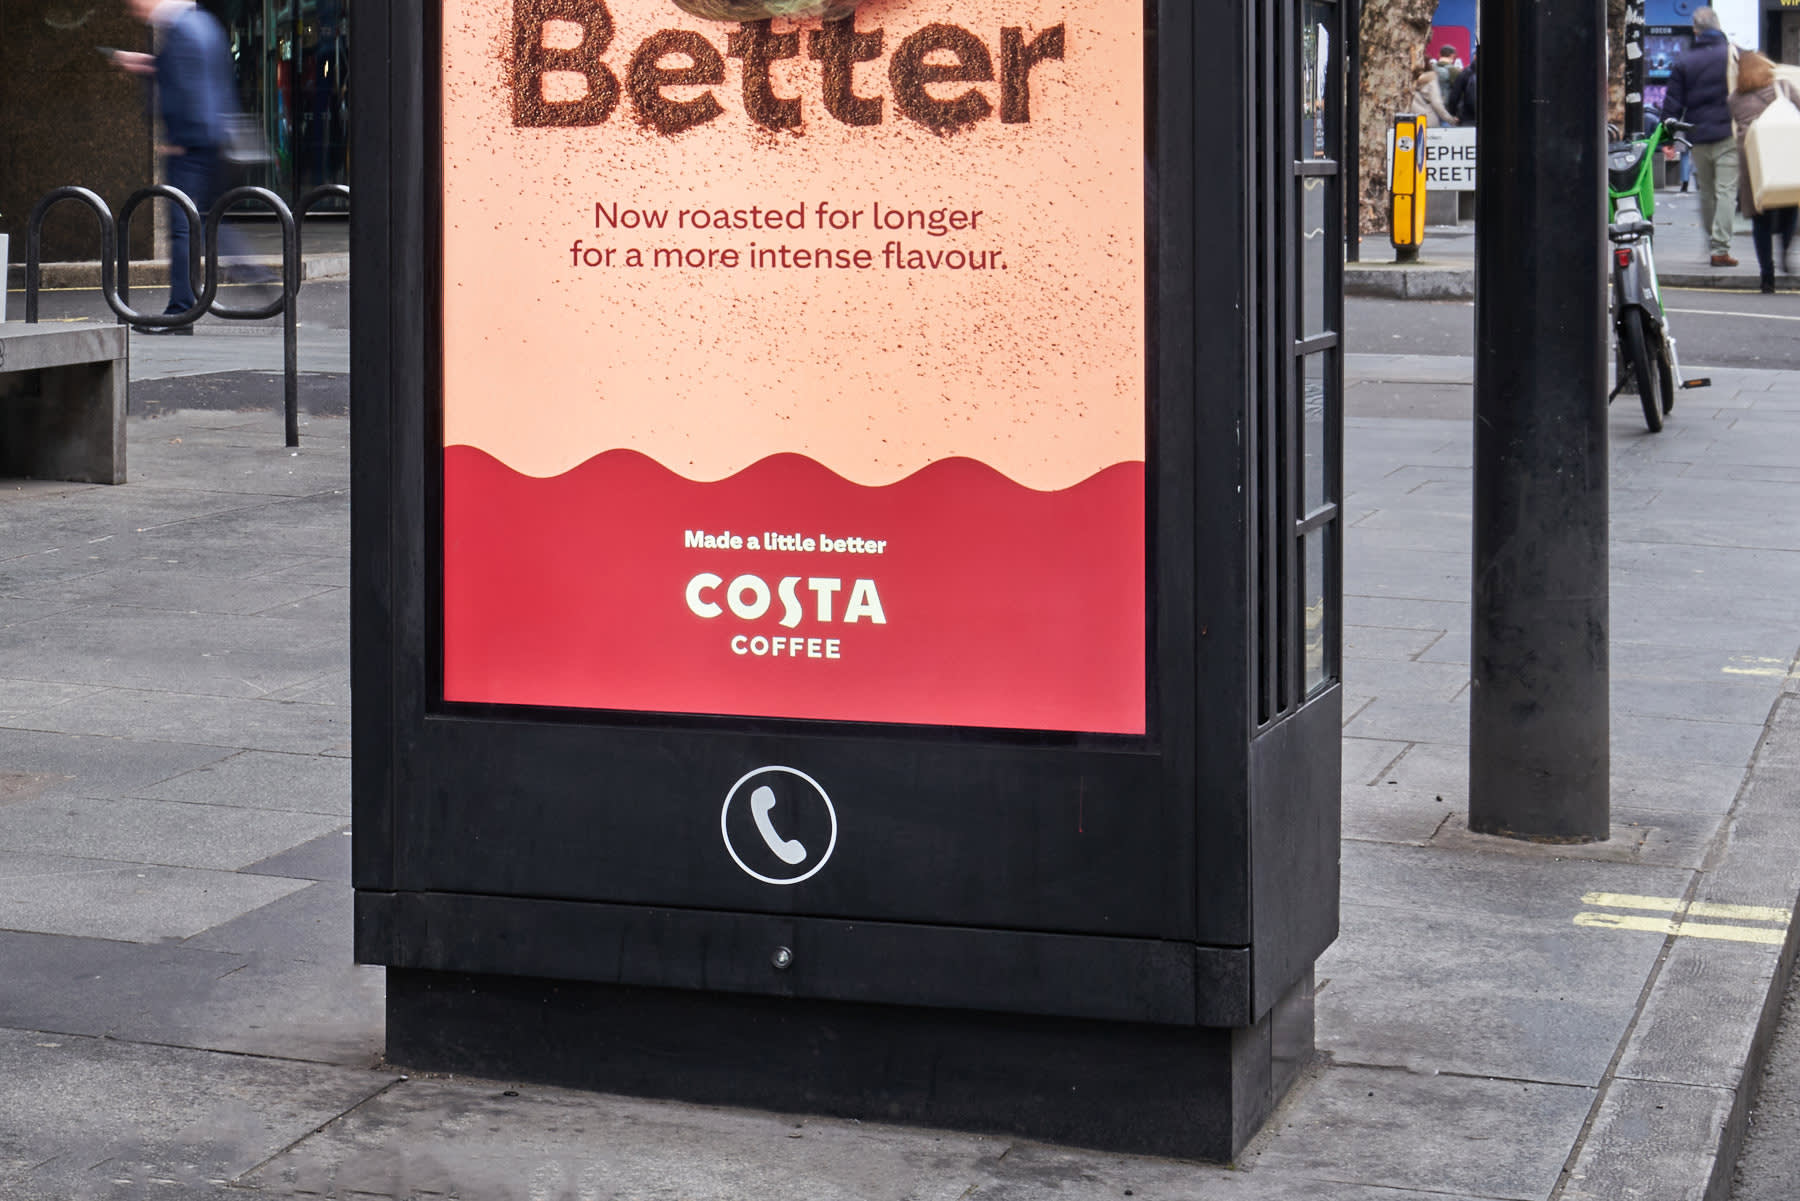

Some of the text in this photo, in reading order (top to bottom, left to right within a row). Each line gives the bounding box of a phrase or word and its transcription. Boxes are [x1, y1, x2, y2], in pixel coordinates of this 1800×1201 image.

[1426, 167, 1476, 181] REET
[595, 201, 984, 237] Now roasted for longer
[569, 239, 1008, 270] for a more intense flavour.
[684, 530, 887, 554] Made a little better
[685, 572, 888, 629] COSTA
[730, 634, 841, 660] COFFEE
